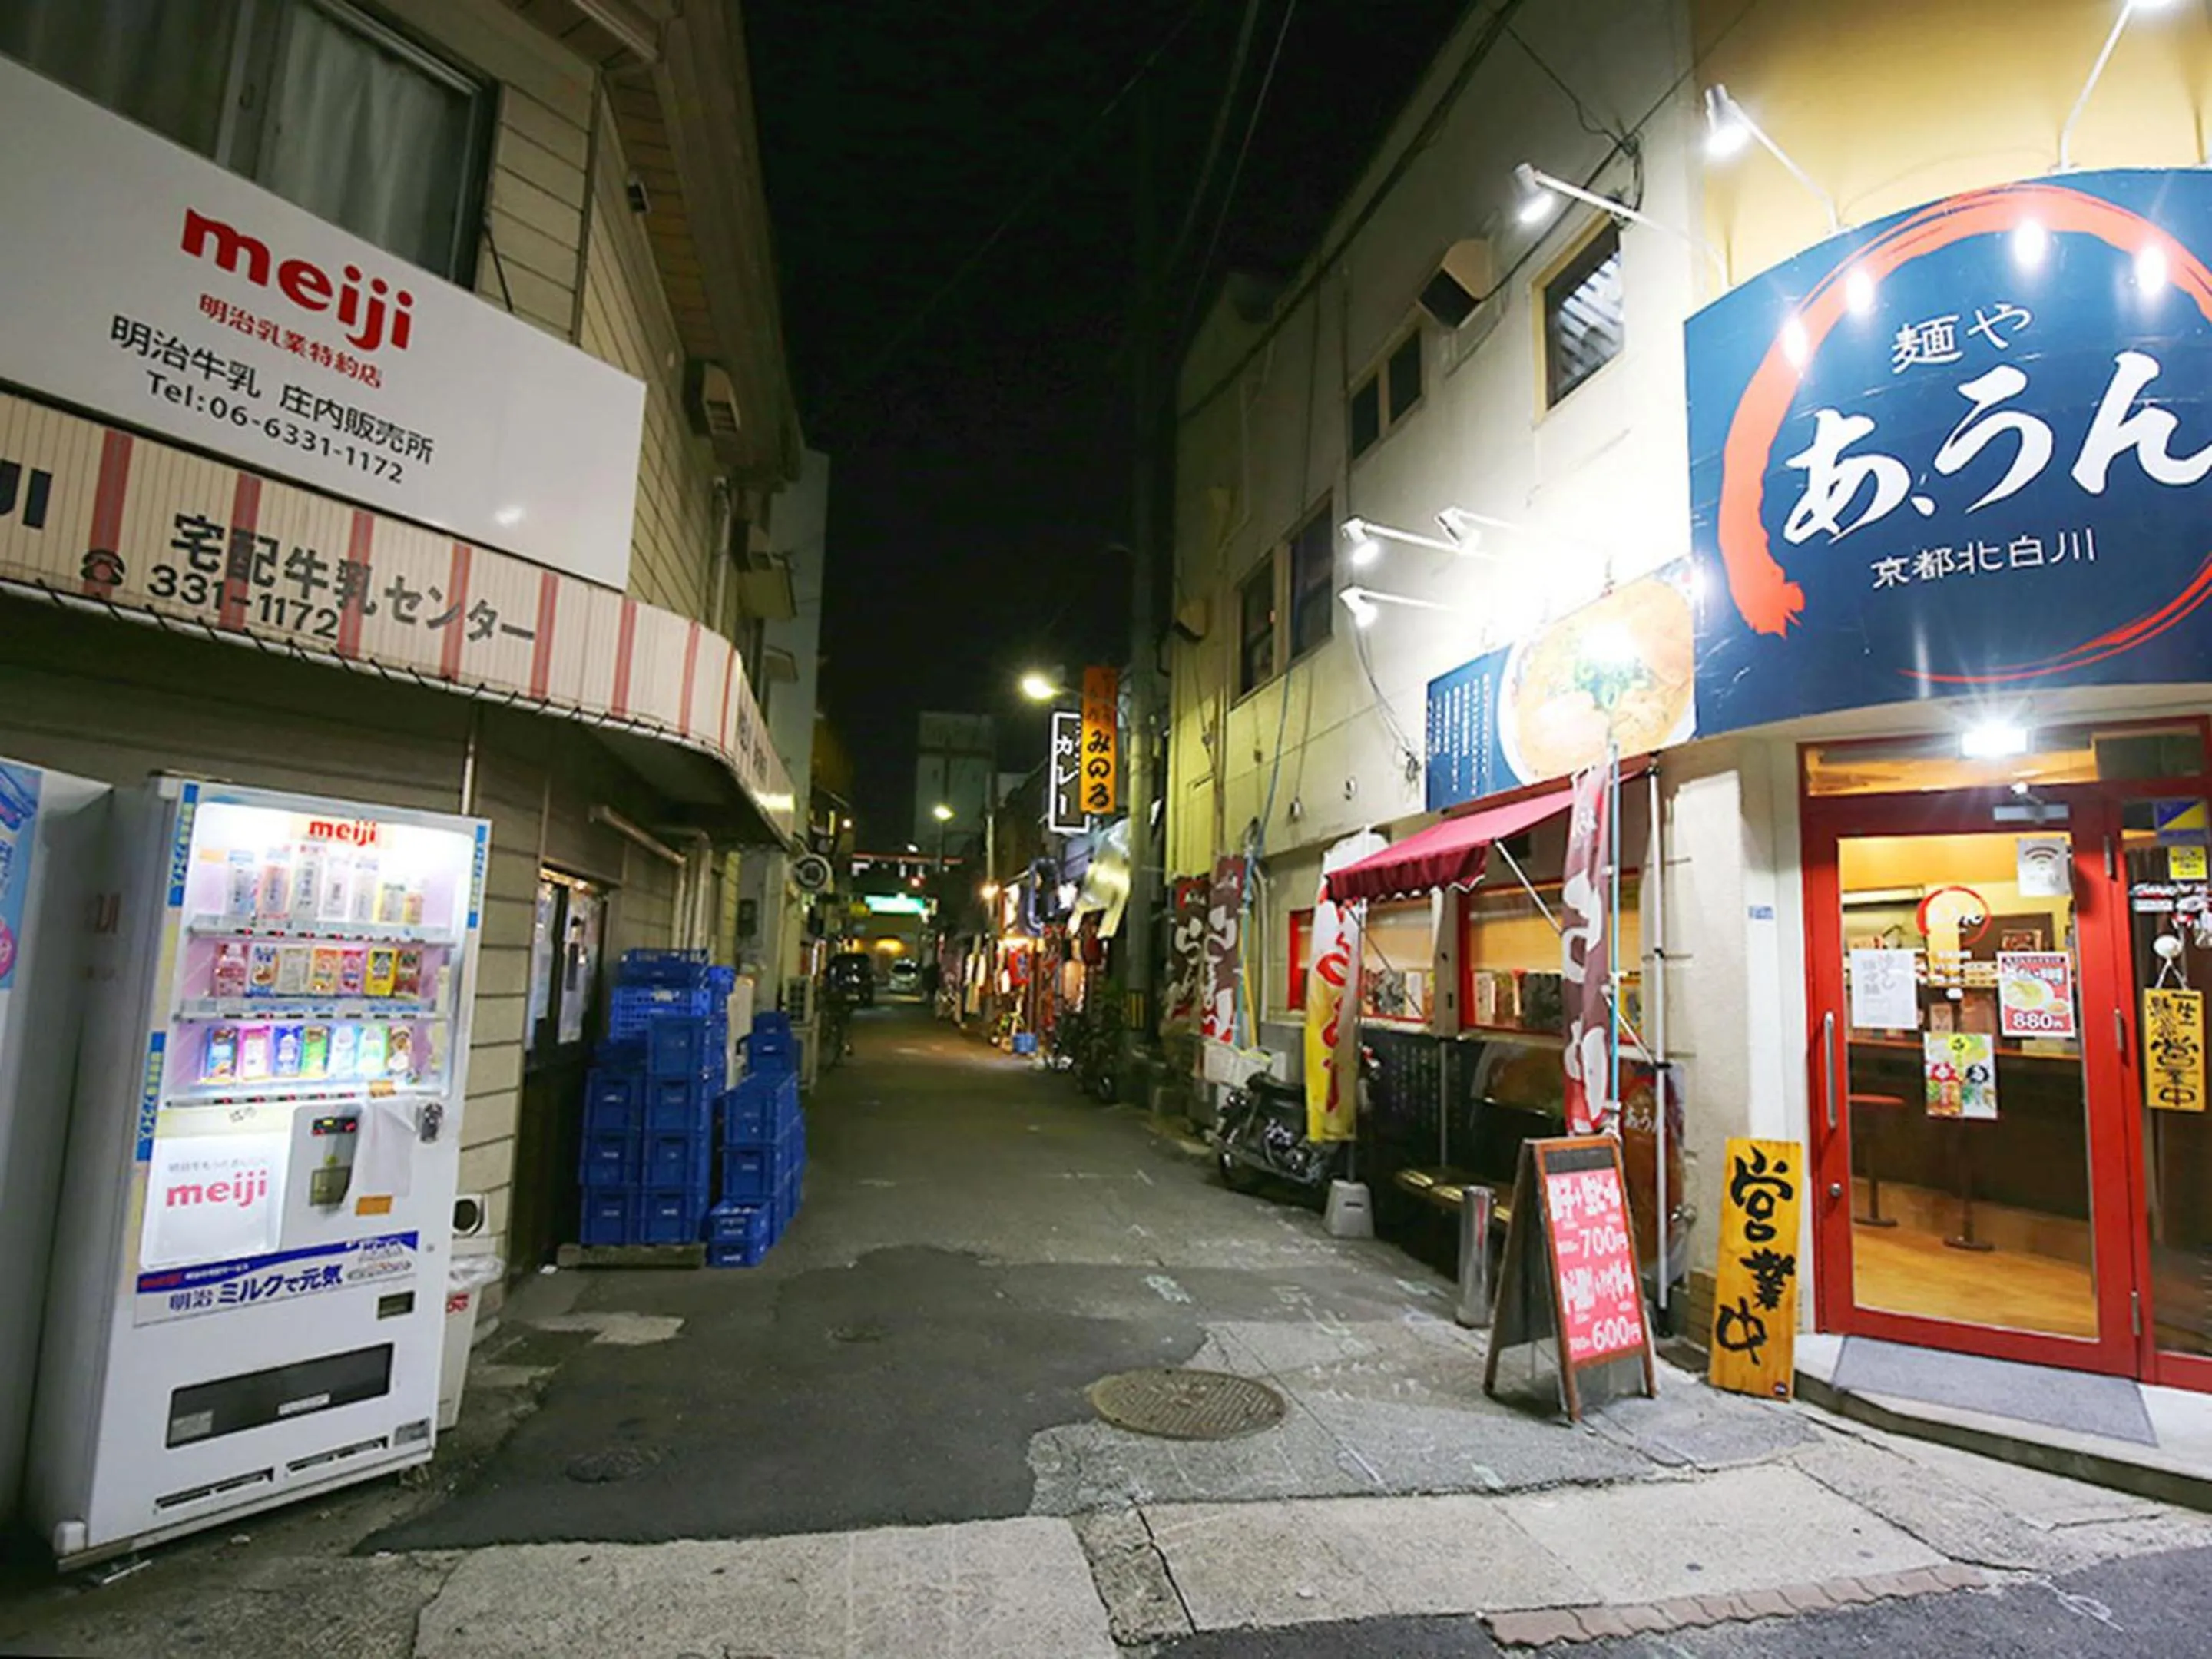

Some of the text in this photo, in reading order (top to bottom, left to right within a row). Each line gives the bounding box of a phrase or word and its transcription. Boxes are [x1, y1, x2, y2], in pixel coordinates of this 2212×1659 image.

[181, 207, 415, 352] meiji
[200, 293, 382, 389] 明治乳業特約店
[1891, 303, 2032, 375] 麺や
[111, 315, 434, 465] 明治牛乳 庄内販売所
[147, 370, 404, 484] Tel:06-6331-1172
[147, 564, 339, 640] 331-1172
[171, 514, 535, 642] 宅配牛乳センター
[1870, 528, 2098, 590] 京都北白川
[309, 819, 377, 846] meiji
[166, 1169, 267, 1208] meiji
[218, 1263, 344, 1304] ミルクで元気
[1716, 1145, 1796, 1366] 営業中
